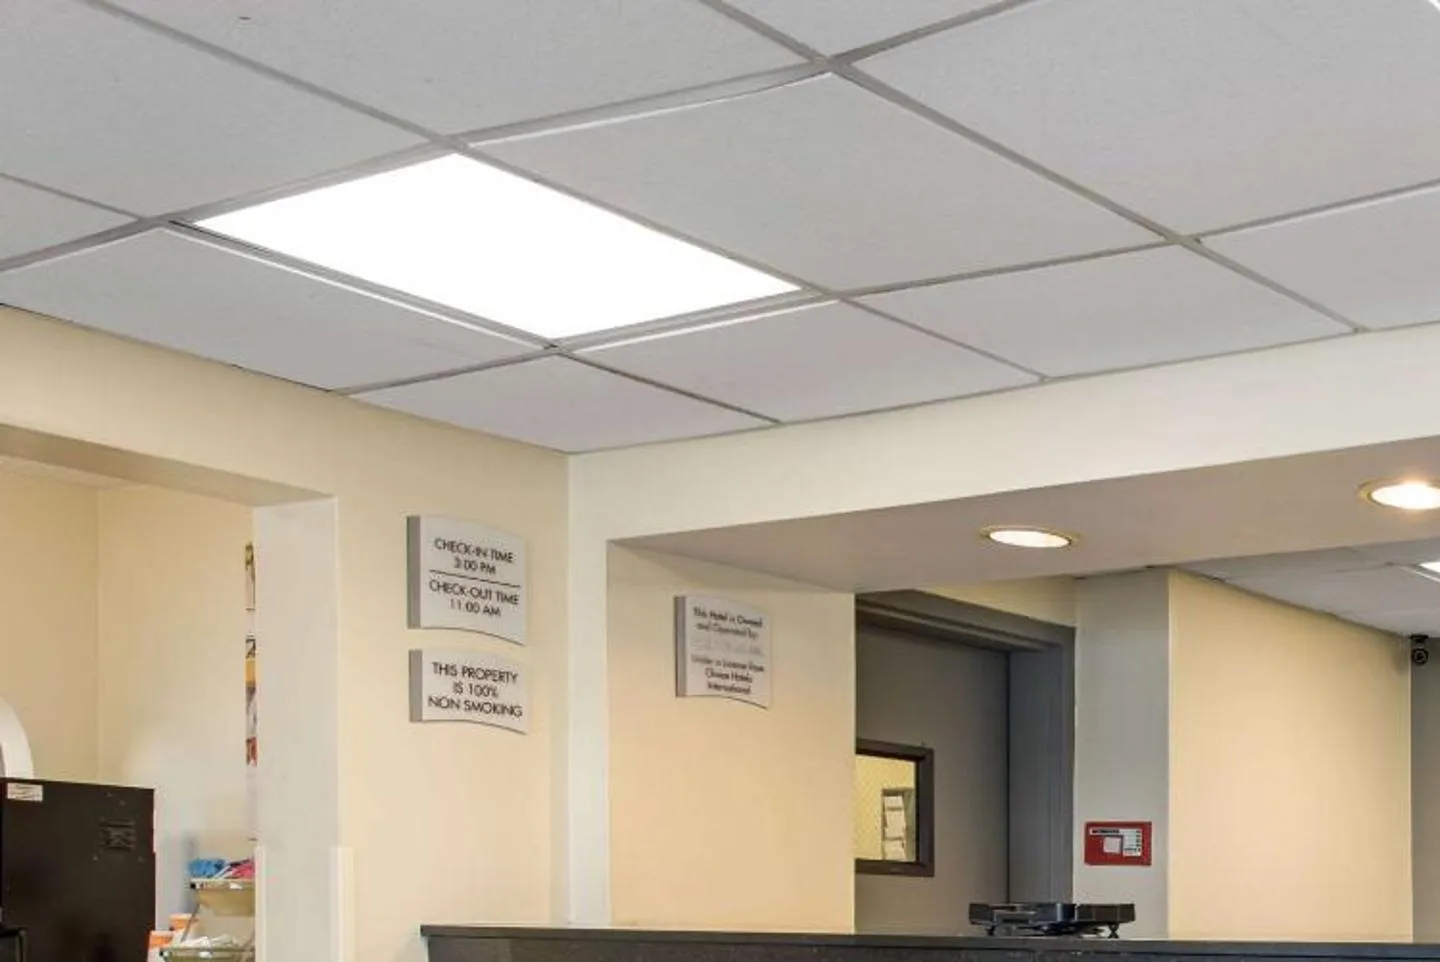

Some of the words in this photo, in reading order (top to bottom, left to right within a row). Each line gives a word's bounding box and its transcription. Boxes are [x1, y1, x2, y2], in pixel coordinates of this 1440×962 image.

[479, 562, 497, 576] PM
[429, 579, 493, 601] CHECK-OUT
[482, 605, 502, 618] AM
[432, 662, 458, 676] THIS
[461, 666, 519, 685] PROPERTY
[454, 682, 464, 695] IS
[468, 684, 499, 698] 100%
[427, 696, 460, 710] NON
[463, 700, 523, 718] SMOKING
